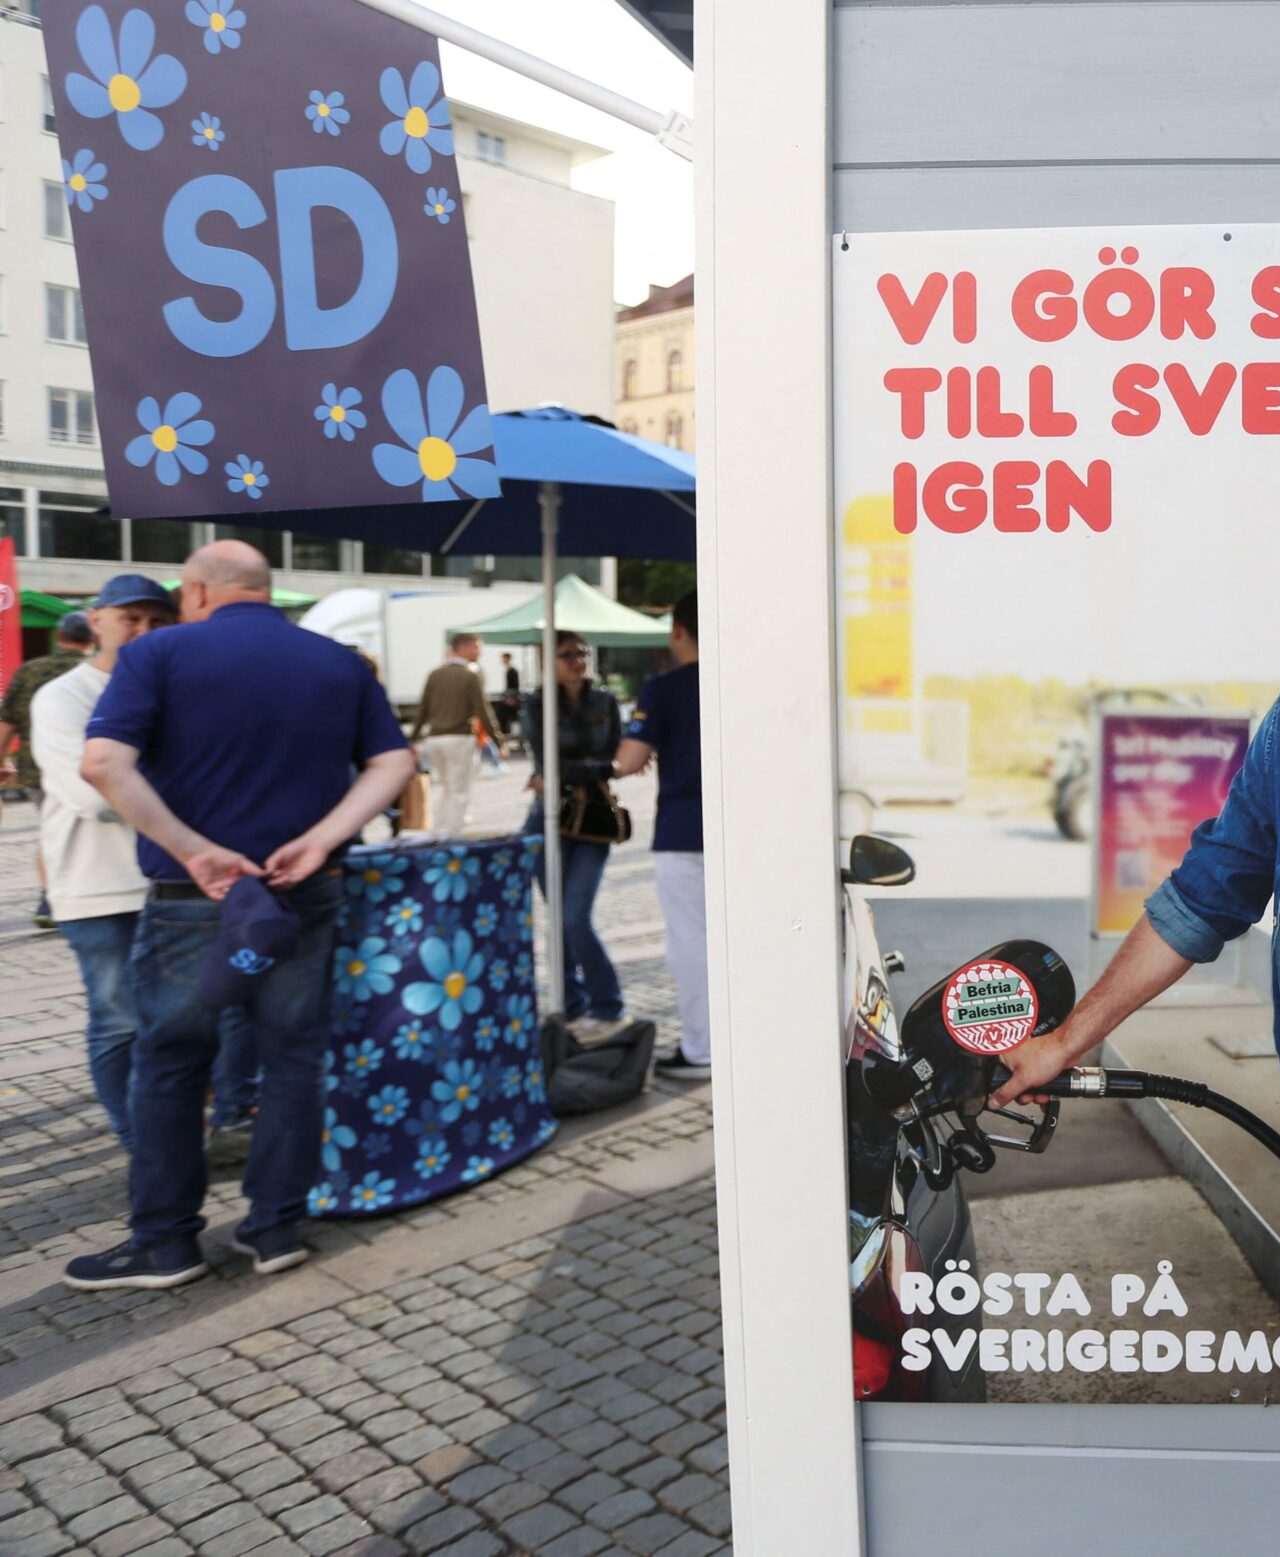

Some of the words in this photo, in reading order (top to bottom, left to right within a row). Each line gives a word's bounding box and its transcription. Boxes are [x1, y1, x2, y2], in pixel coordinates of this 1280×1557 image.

[163, 166, 398, 357] SD
[877, 271, 977, 344] VI
[1011, 246, 1216, 342] GÖR
[884, 365, 1077, 439] TILL
[893, 459, 1112, 534] IGEN
[957, 1002, 1025, 1021] Palestina
[966, 982, 1012, 998] Befria
[899, 1259, 1091, 1316] RÖSTA
[1111, 1260, 1188, 1317] PÅ
